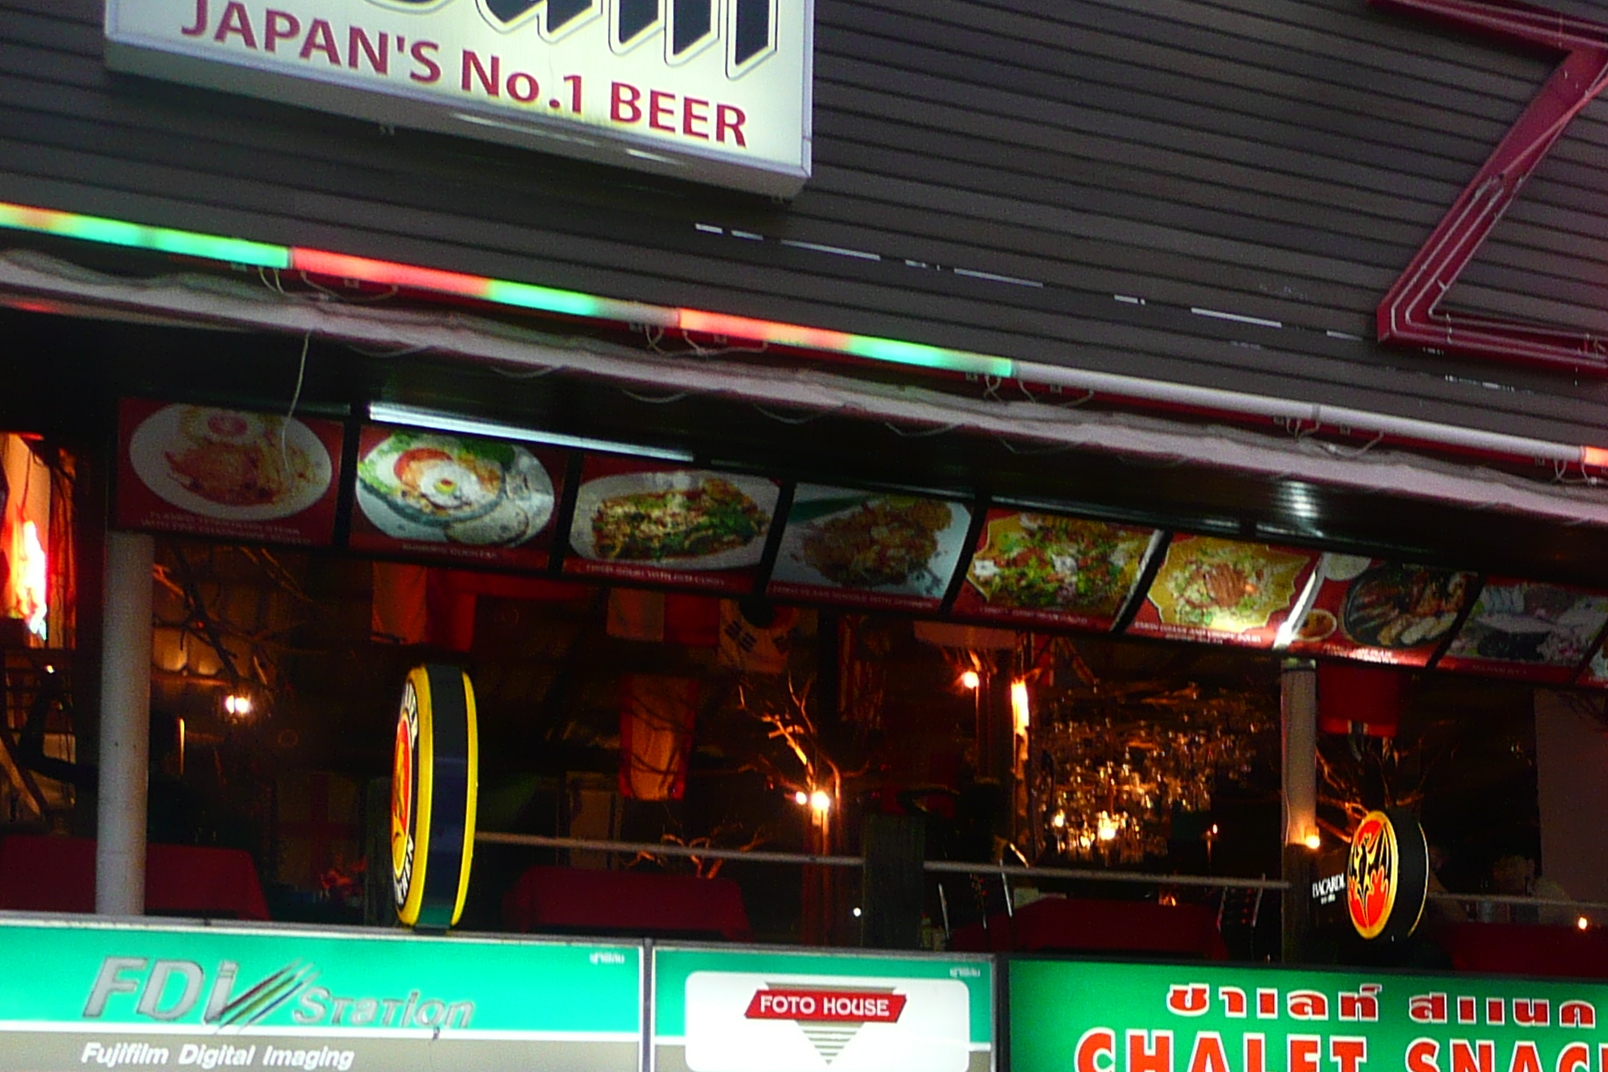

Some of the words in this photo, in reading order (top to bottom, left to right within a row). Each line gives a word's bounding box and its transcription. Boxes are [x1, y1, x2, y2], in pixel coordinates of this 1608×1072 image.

[181, 0, 442, 85] JAPAN'S
[459, 48, 586, 114] No.1
[608, 79, 749, 148] BEER
[1312, 872, 1346, 898] BACARDI
[759, 994, 818, 1017] FOTO
[824, 995, 890, 1019] HOUSE
[80, 1041, 169, 1066] Fujifilm
[178, 1043, 256, 1069] Digital
[262, 1045, 355, 1071] Imaging
